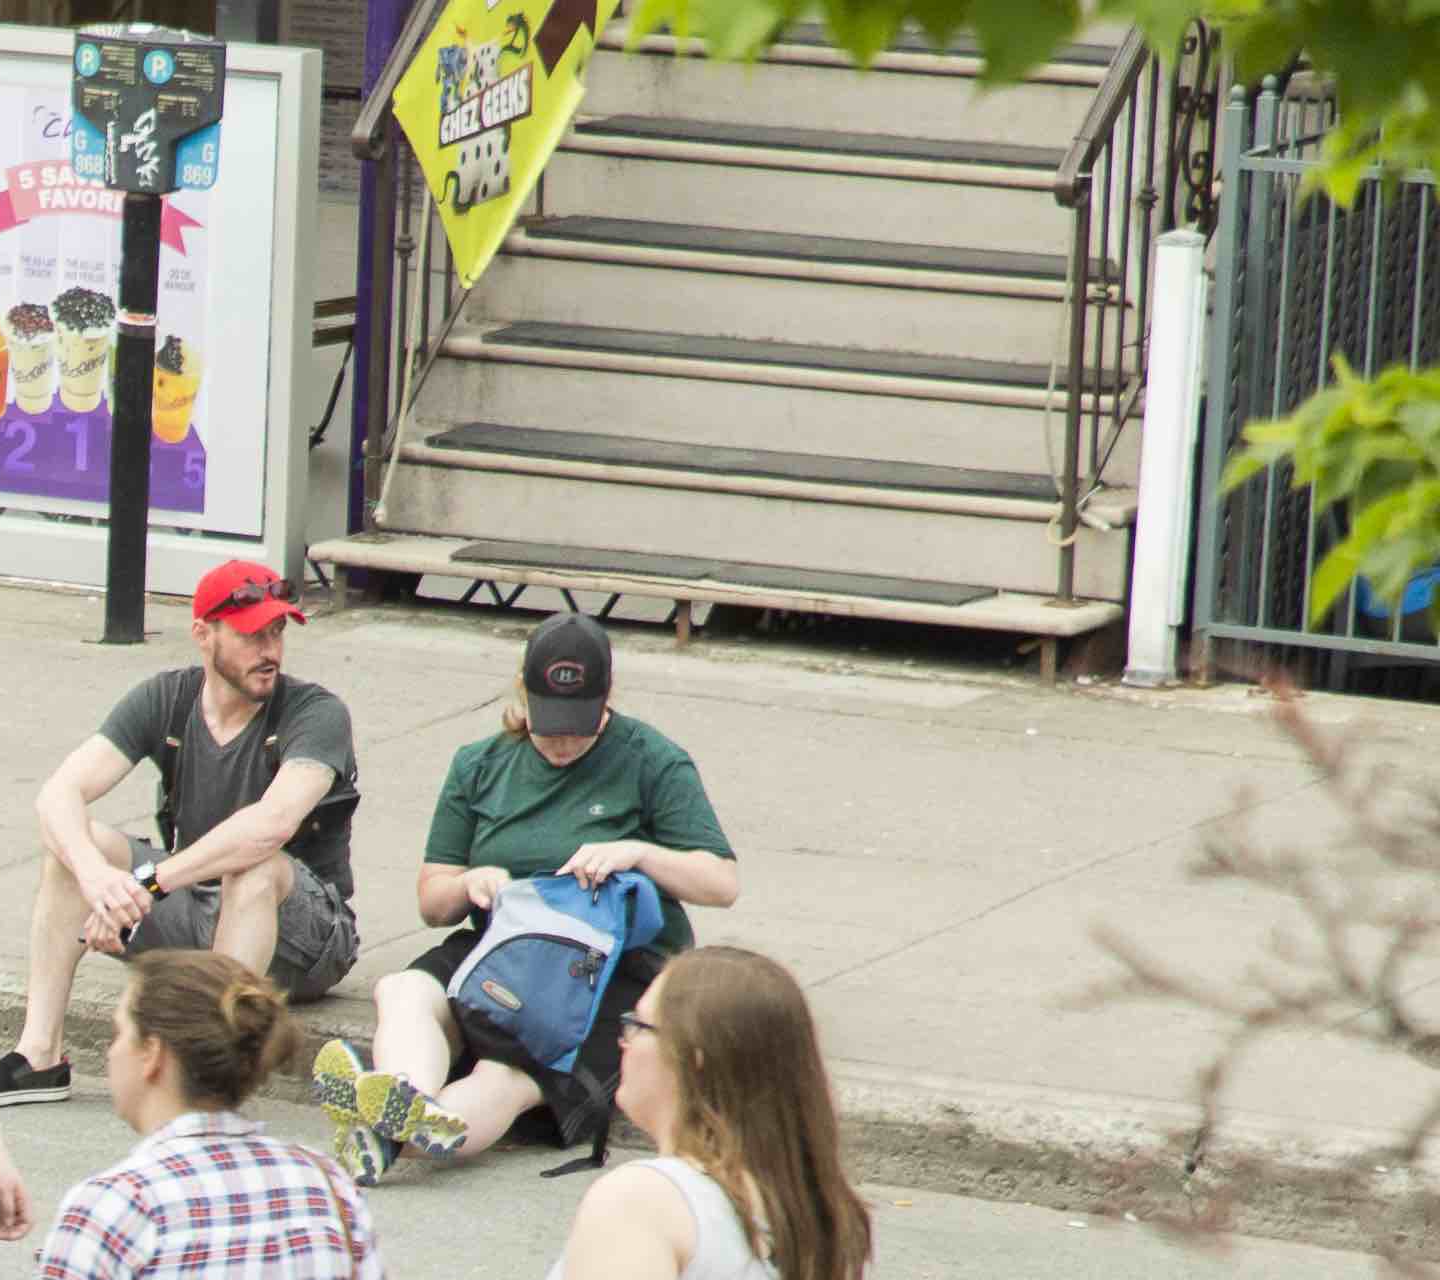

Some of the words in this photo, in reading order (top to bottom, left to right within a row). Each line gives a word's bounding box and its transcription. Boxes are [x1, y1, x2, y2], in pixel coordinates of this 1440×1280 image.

[440, 96, 480, 146] CHEZ
[481, 64, 529, 129] GEEKS
[75, 129, 87, 150] G
[203, 144, 215, 162] G
[19, 169, 35, 189] 5
[3, 420, 38, 473] 2
[66, 416, 90, 472] 1
[183, 451, 205, 489] 5
